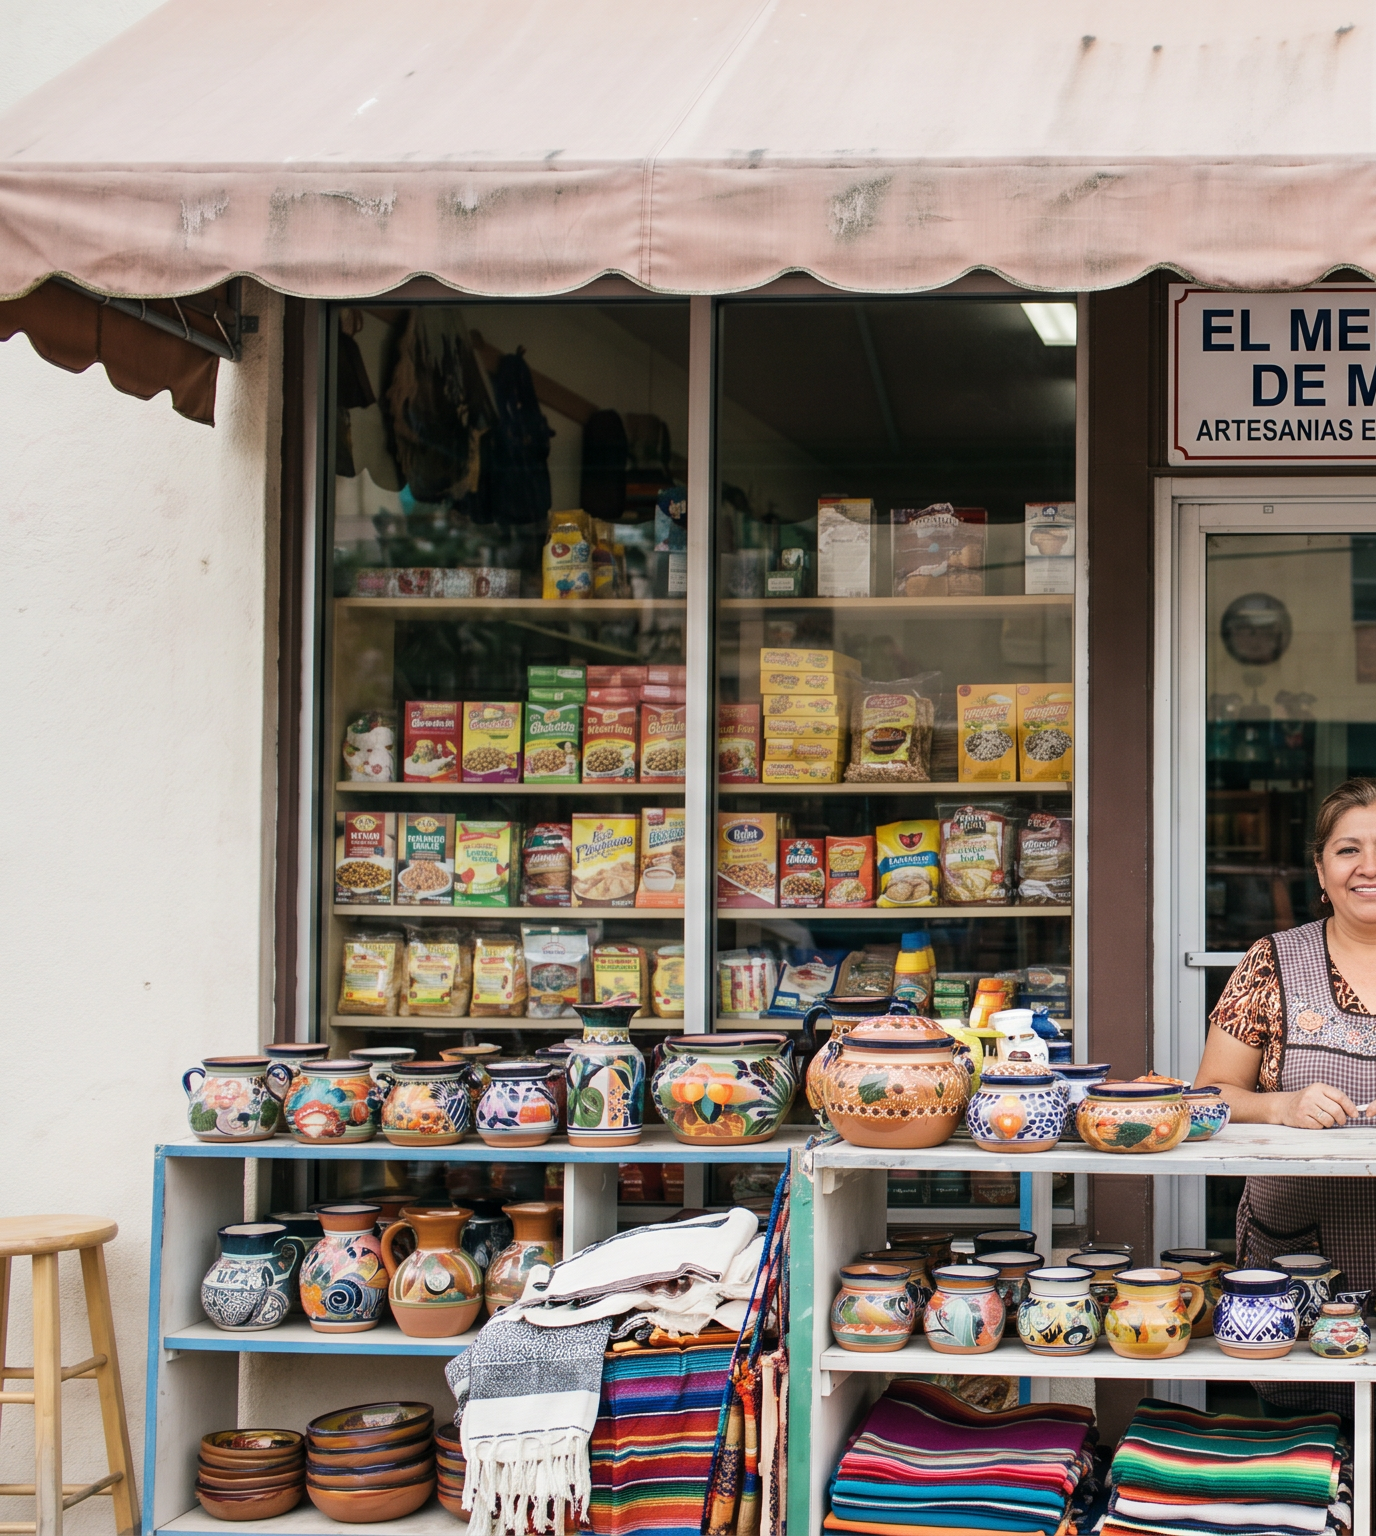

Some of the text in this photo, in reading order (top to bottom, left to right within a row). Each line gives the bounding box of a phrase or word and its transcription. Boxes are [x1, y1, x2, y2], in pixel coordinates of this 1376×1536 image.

[1202, 308, 1271, 352] EL
[1252, 363, 1326, 407] DE
[1195, 418, 1353, 442] ARTESANIAS
[1361, 419, 1376, 441] E
